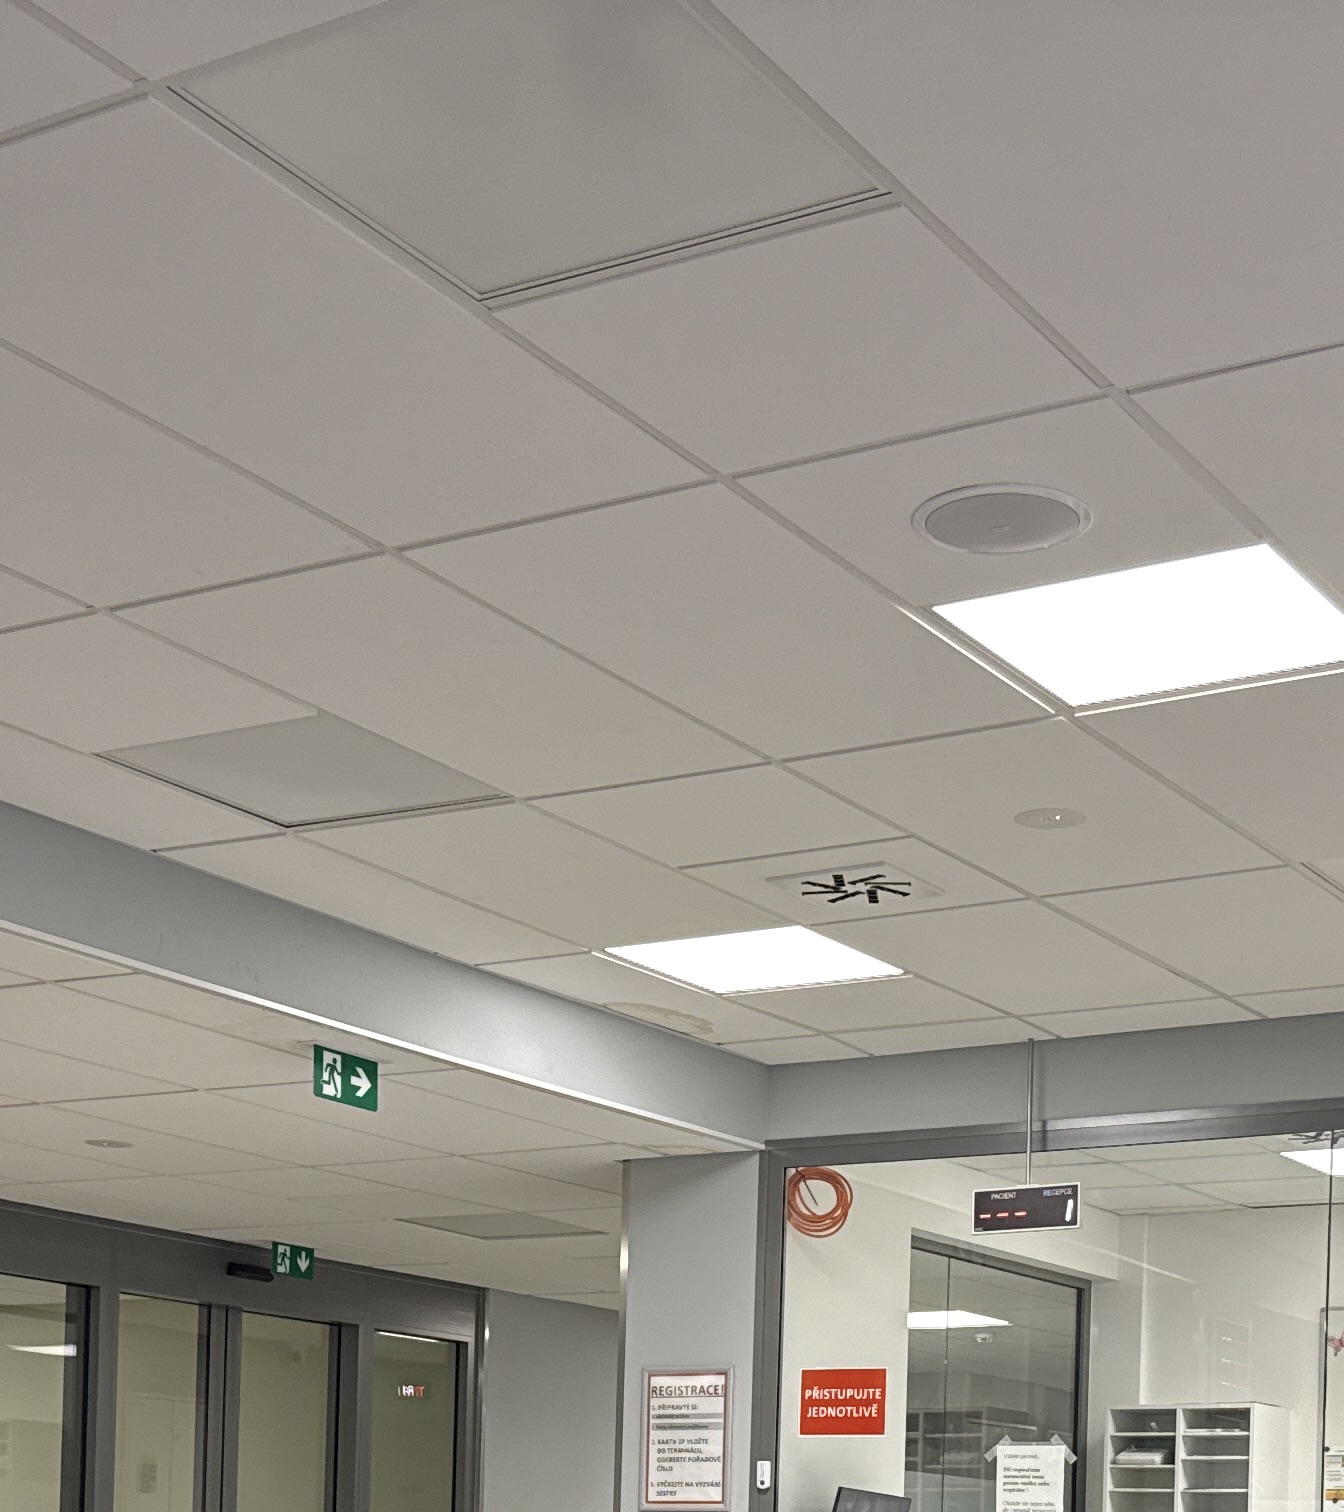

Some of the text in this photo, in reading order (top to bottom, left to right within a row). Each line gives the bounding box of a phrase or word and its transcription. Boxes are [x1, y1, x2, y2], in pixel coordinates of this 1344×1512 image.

[990, 1188, 1073, 1200] PACIENT RECEPCE
[1065, 1199, 1074, 1221] 1
[651, 1384, 725, 1396] REGISTRACE!
[805, 1385, 882, 1400] PŘISTUPUJTE
[806, 1403, 878, 1418] JEDNOTLIVĚ
